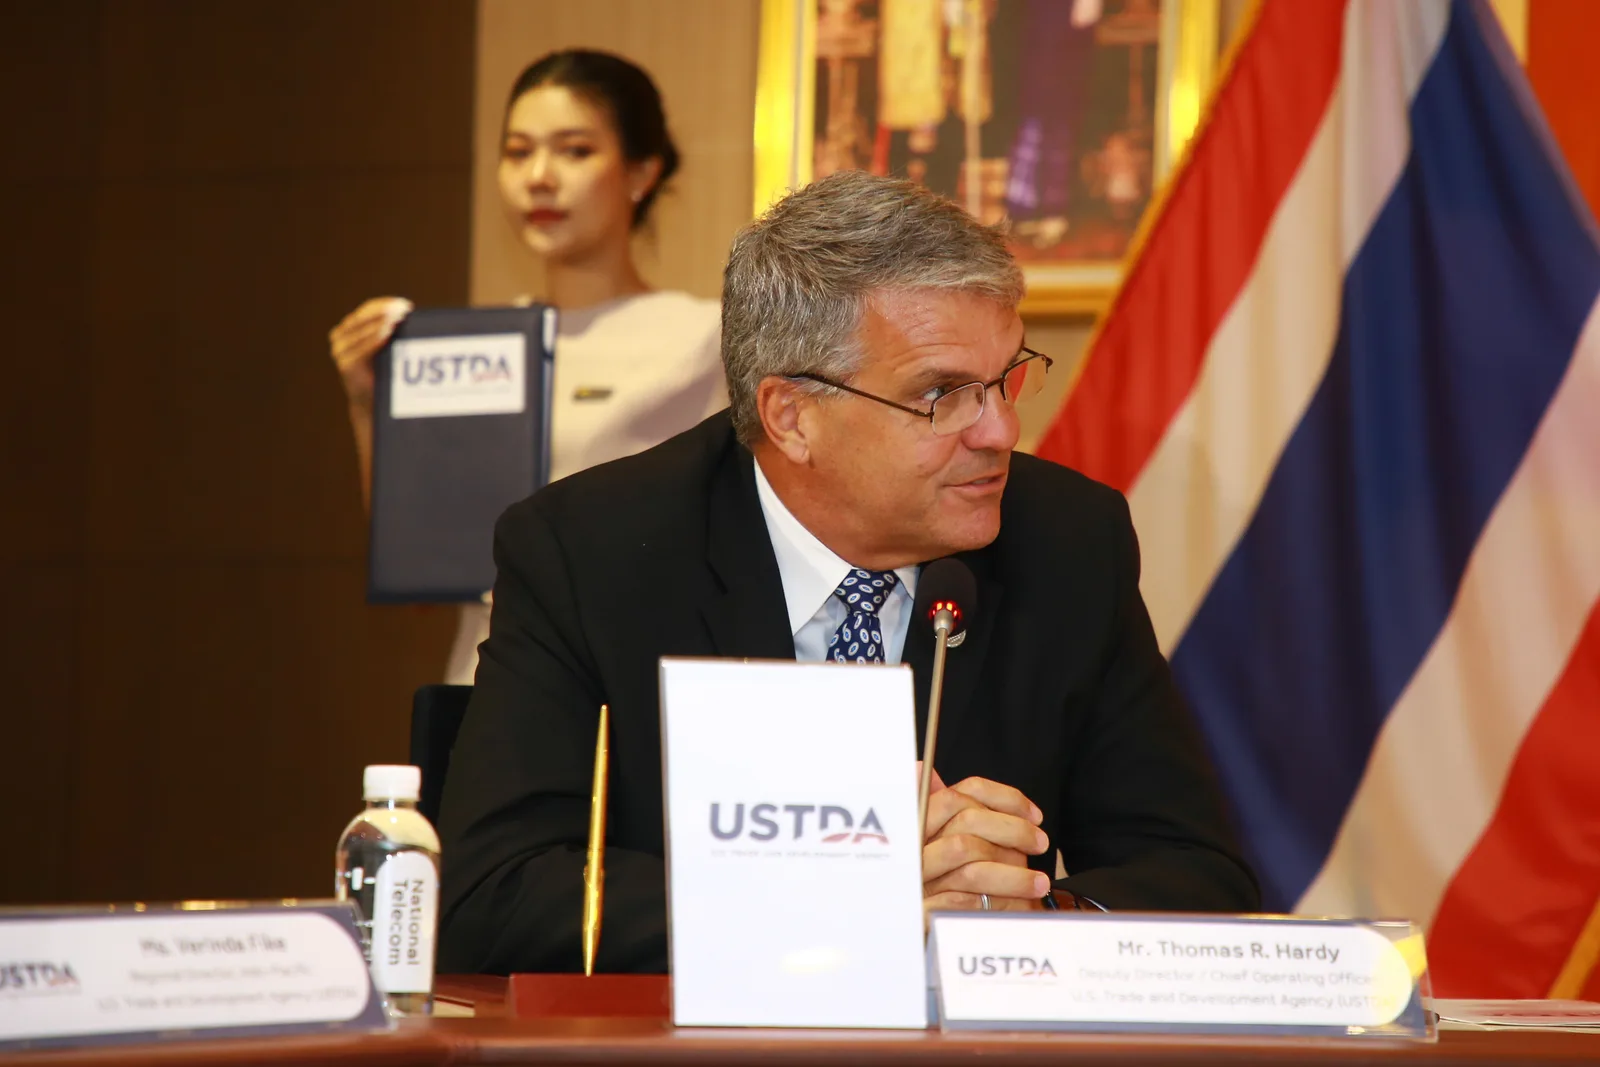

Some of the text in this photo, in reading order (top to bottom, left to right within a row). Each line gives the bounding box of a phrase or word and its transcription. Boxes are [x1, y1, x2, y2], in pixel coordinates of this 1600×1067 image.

[402, 354, 512, 385] USTDA
[709, 803, 889, 844] USTDA
[388, 880, 408, 966] Telecom
[406, 879, 424, 965] National
[1117, 940, 1340, 963] Mr. Thomas R. Hardy
[957, 956, 1059, 978] USTDA
[1078, 967, 1130, 982] Deputy
[1134, 968, 1194, 981] Director
[1210, 969, 1249, 983] Chief
[1252, 970, 1326, 987] Operating
[1328, 971, 1379, 986] Office
[1104, 990, 1145, 1003] Trade
[1149, 991, 1175, 1004] and
[1179, 991, 1275, 1008] Development
[1280, 993, 1333, 1009] Agency
